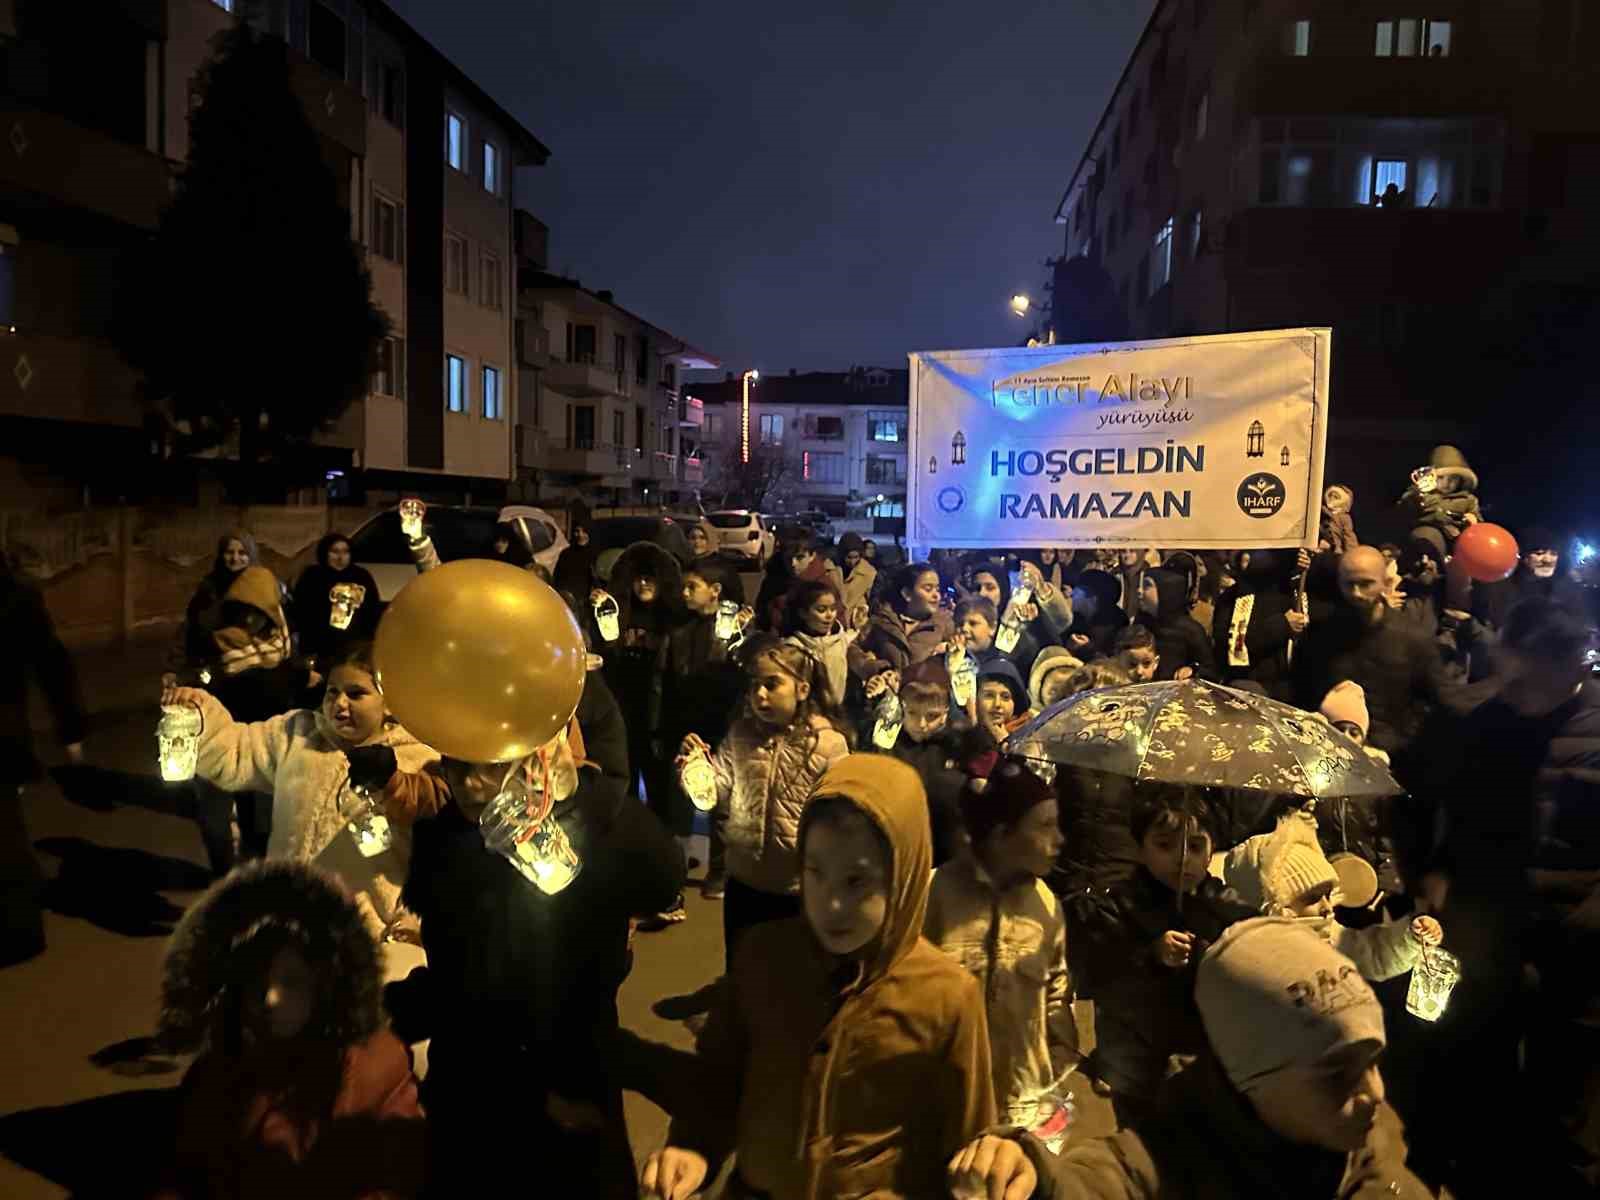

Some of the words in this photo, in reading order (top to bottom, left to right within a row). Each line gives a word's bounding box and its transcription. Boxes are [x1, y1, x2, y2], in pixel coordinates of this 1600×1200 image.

[1098, 373, 1191, 408] Alayı
[1096, 407, 1195, 430] yürüyüşü
[991, 439, 1205, 483] HOŞGELDİN
[999, 490, 1191, 519] RAMAZAN
[1243, 496, 1281, 507] IHARF
